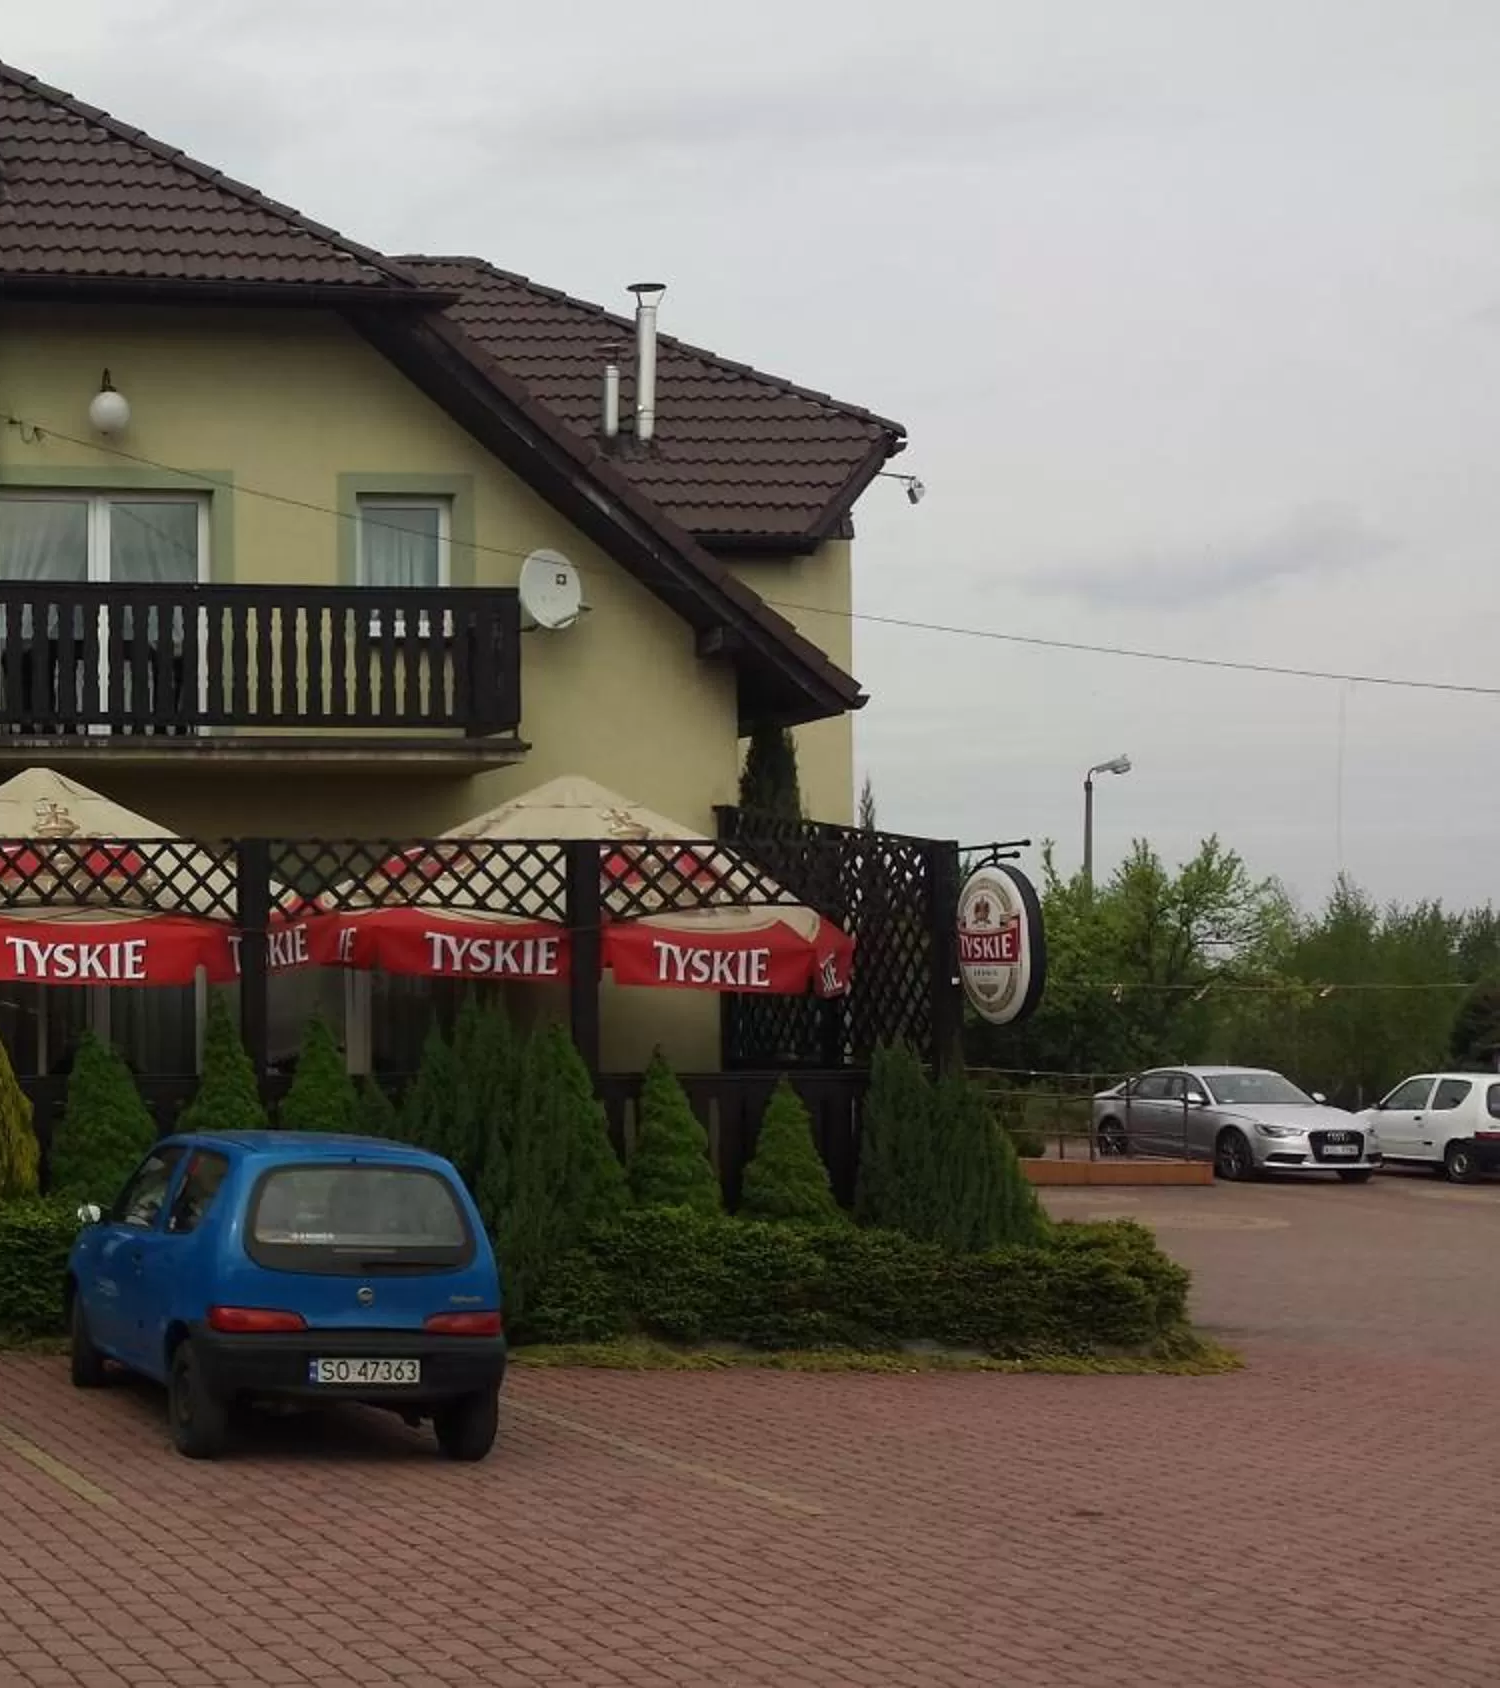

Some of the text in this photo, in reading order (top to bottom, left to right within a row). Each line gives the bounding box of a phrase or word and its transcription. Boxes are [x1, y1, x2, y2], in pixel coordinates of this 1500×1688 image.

[5, 936, 147, 979] TYSKIE
[227, 924, 309, 975] TKIE
[424, 931, 560, 975] TYSKIE
[652, 939, 772, 987] TYSKIE
[959, 932, 1014, 961] TYSKIE
[357, 1361, 417, 1381] 47363
